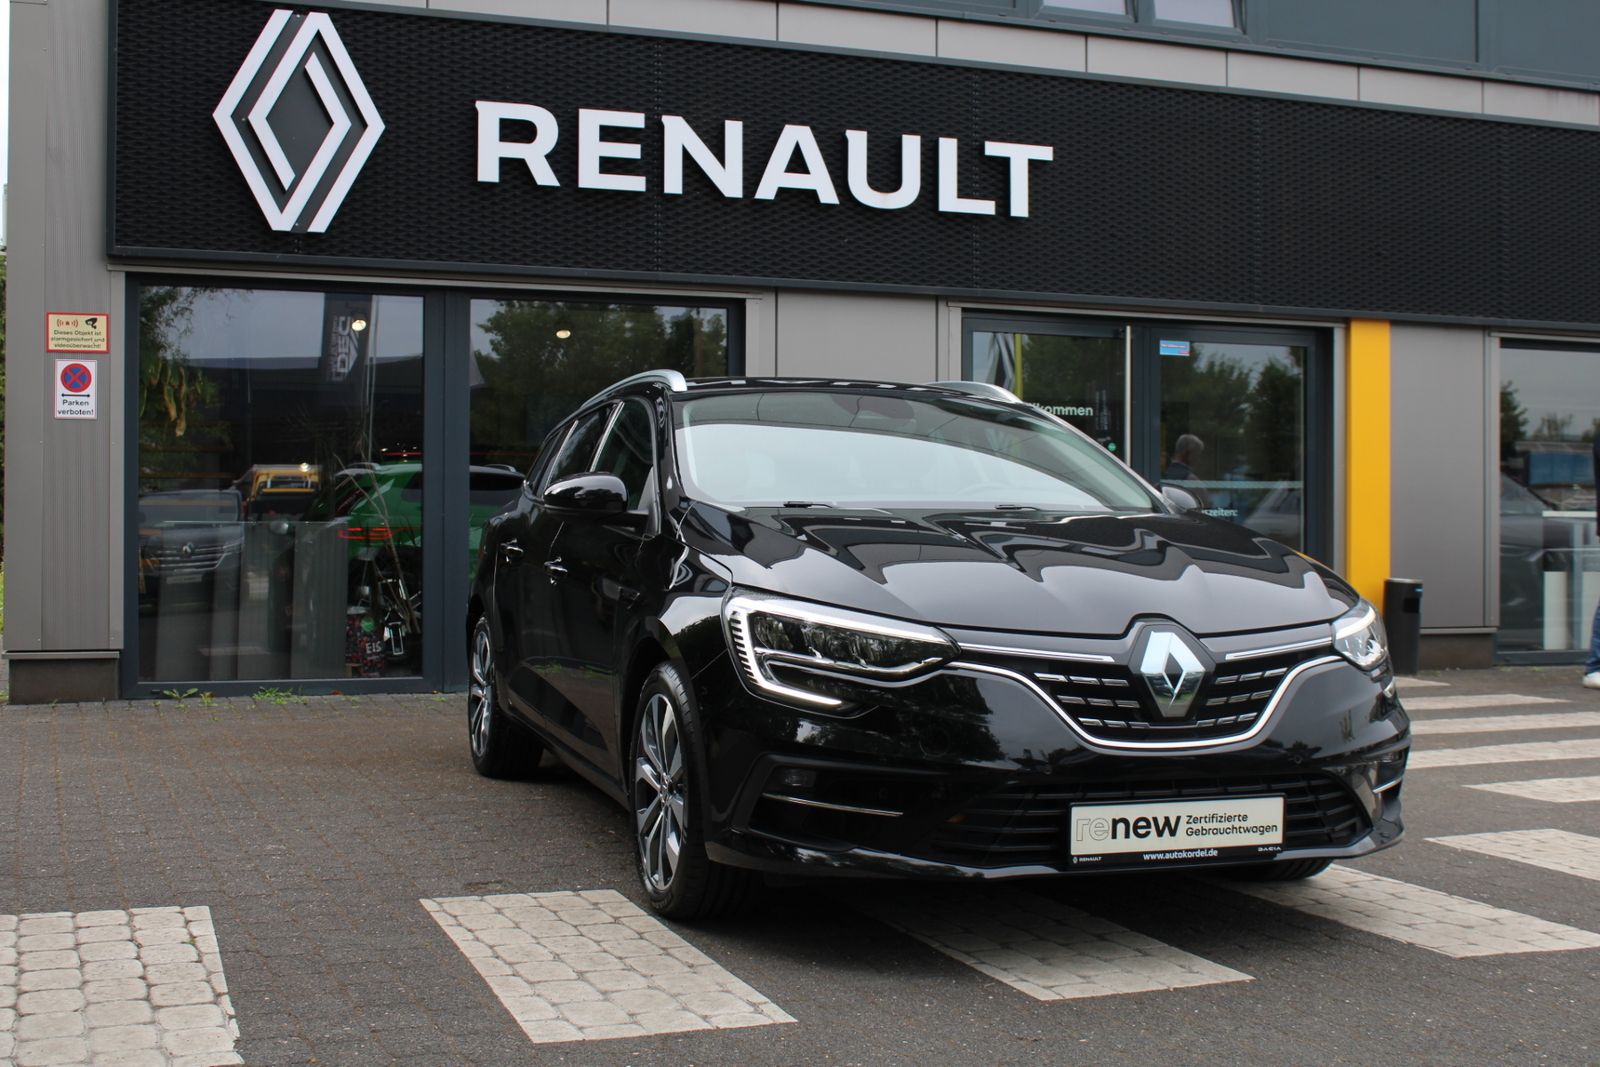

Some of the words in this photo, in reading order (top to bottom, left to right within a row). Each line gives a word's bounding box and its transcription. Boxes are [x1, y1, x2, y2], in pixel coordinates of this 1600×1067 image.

[475, 100, 1054, 219] RENAULT
[1186, 813, 1248, 824] Zertifizierte
[1076, 815, 1181, 842] renew
[1186, 824, 1278, 836] Gebrauchtwagen
[1143, 848, 1218, 860] www.autokordel.de
